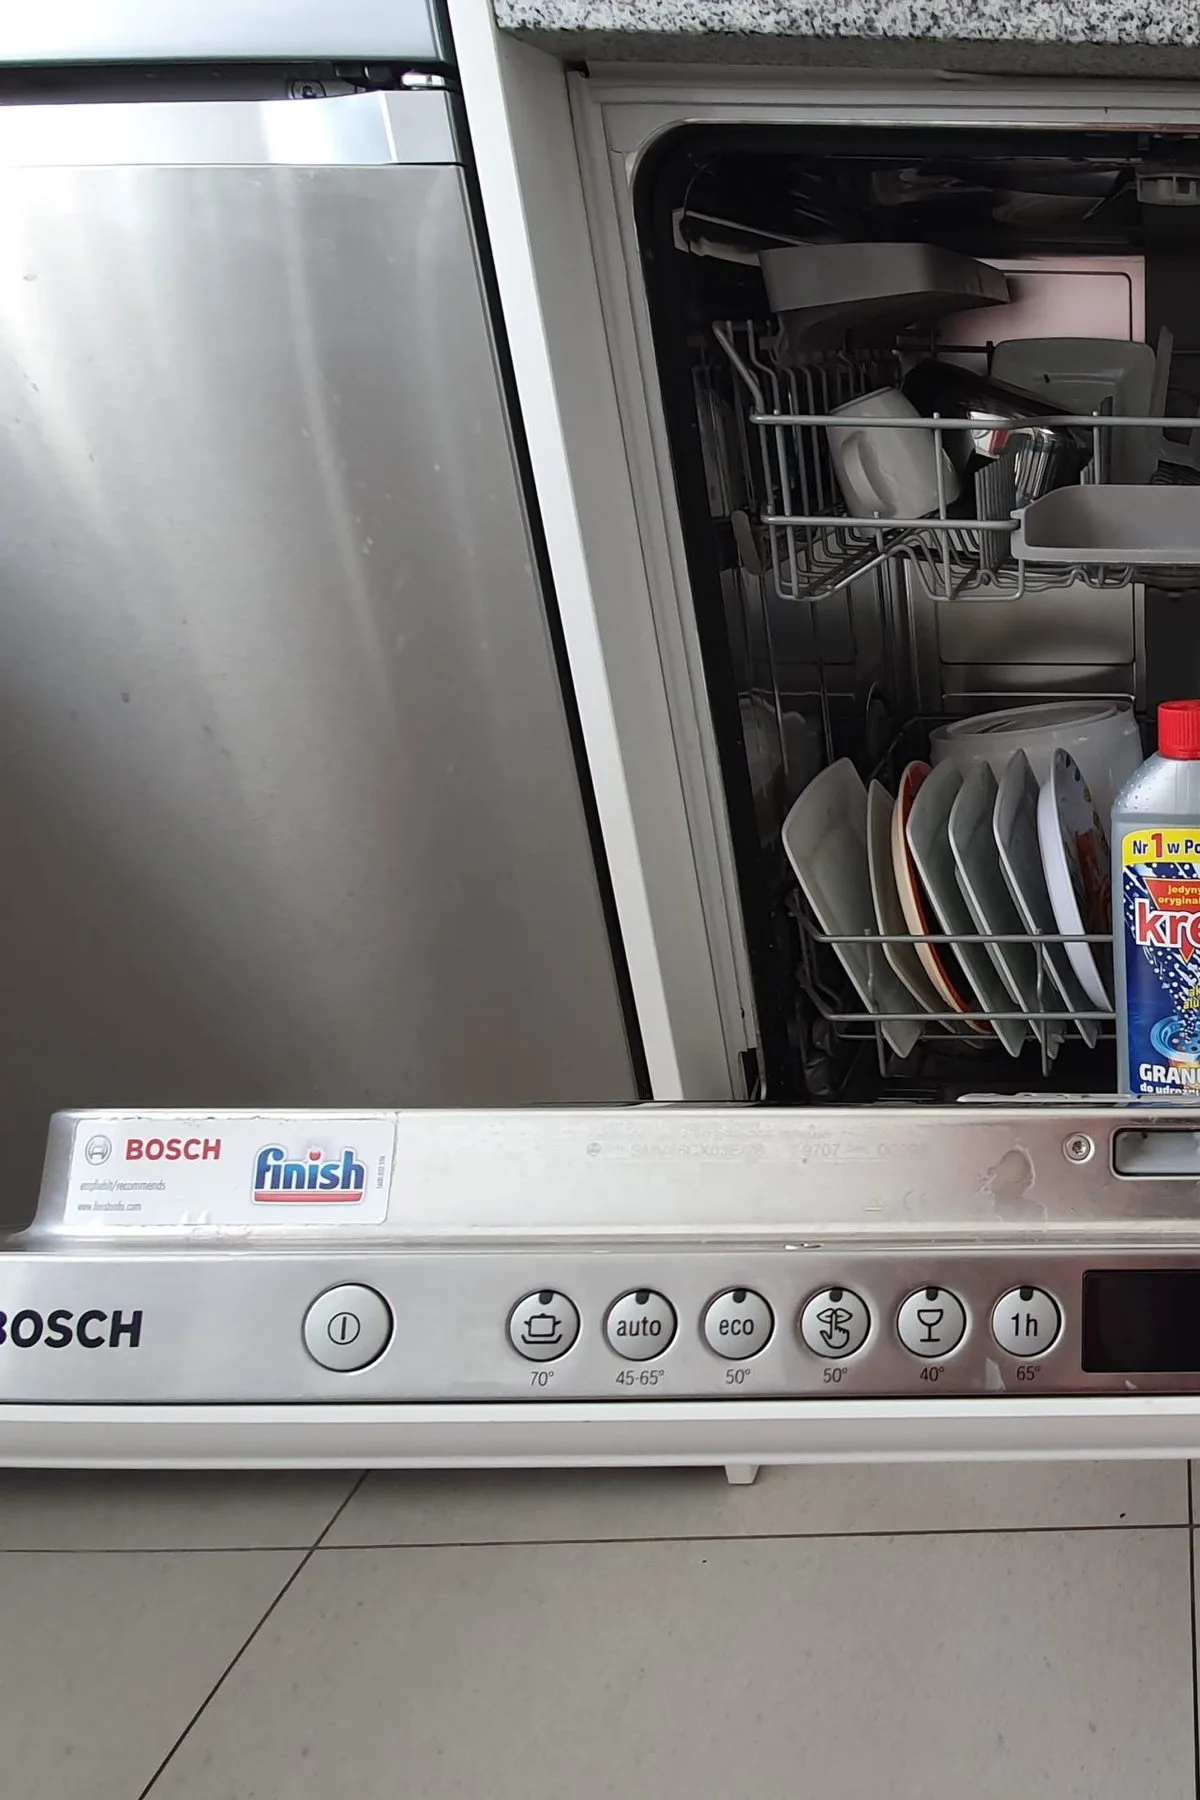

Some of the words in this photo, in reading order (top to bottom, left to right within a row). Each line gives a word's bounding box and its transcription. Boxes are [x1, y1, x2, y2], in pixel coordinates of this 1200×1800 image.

[1132, 840, 1149, 855] Nr
[1151, 832, 1163, 858] 1
[1167, 843, 1180, 854] w
[1140, 1082, 1154, 1093] do
[126, 1138, 222, 1161] BOSCH
[254, 1147, 365, 1190] finish
[0, 1309, 143, 1348] OSCH
[616, 1315, 662, 1337] auto
[718, 1318, 754, 1336] eco
